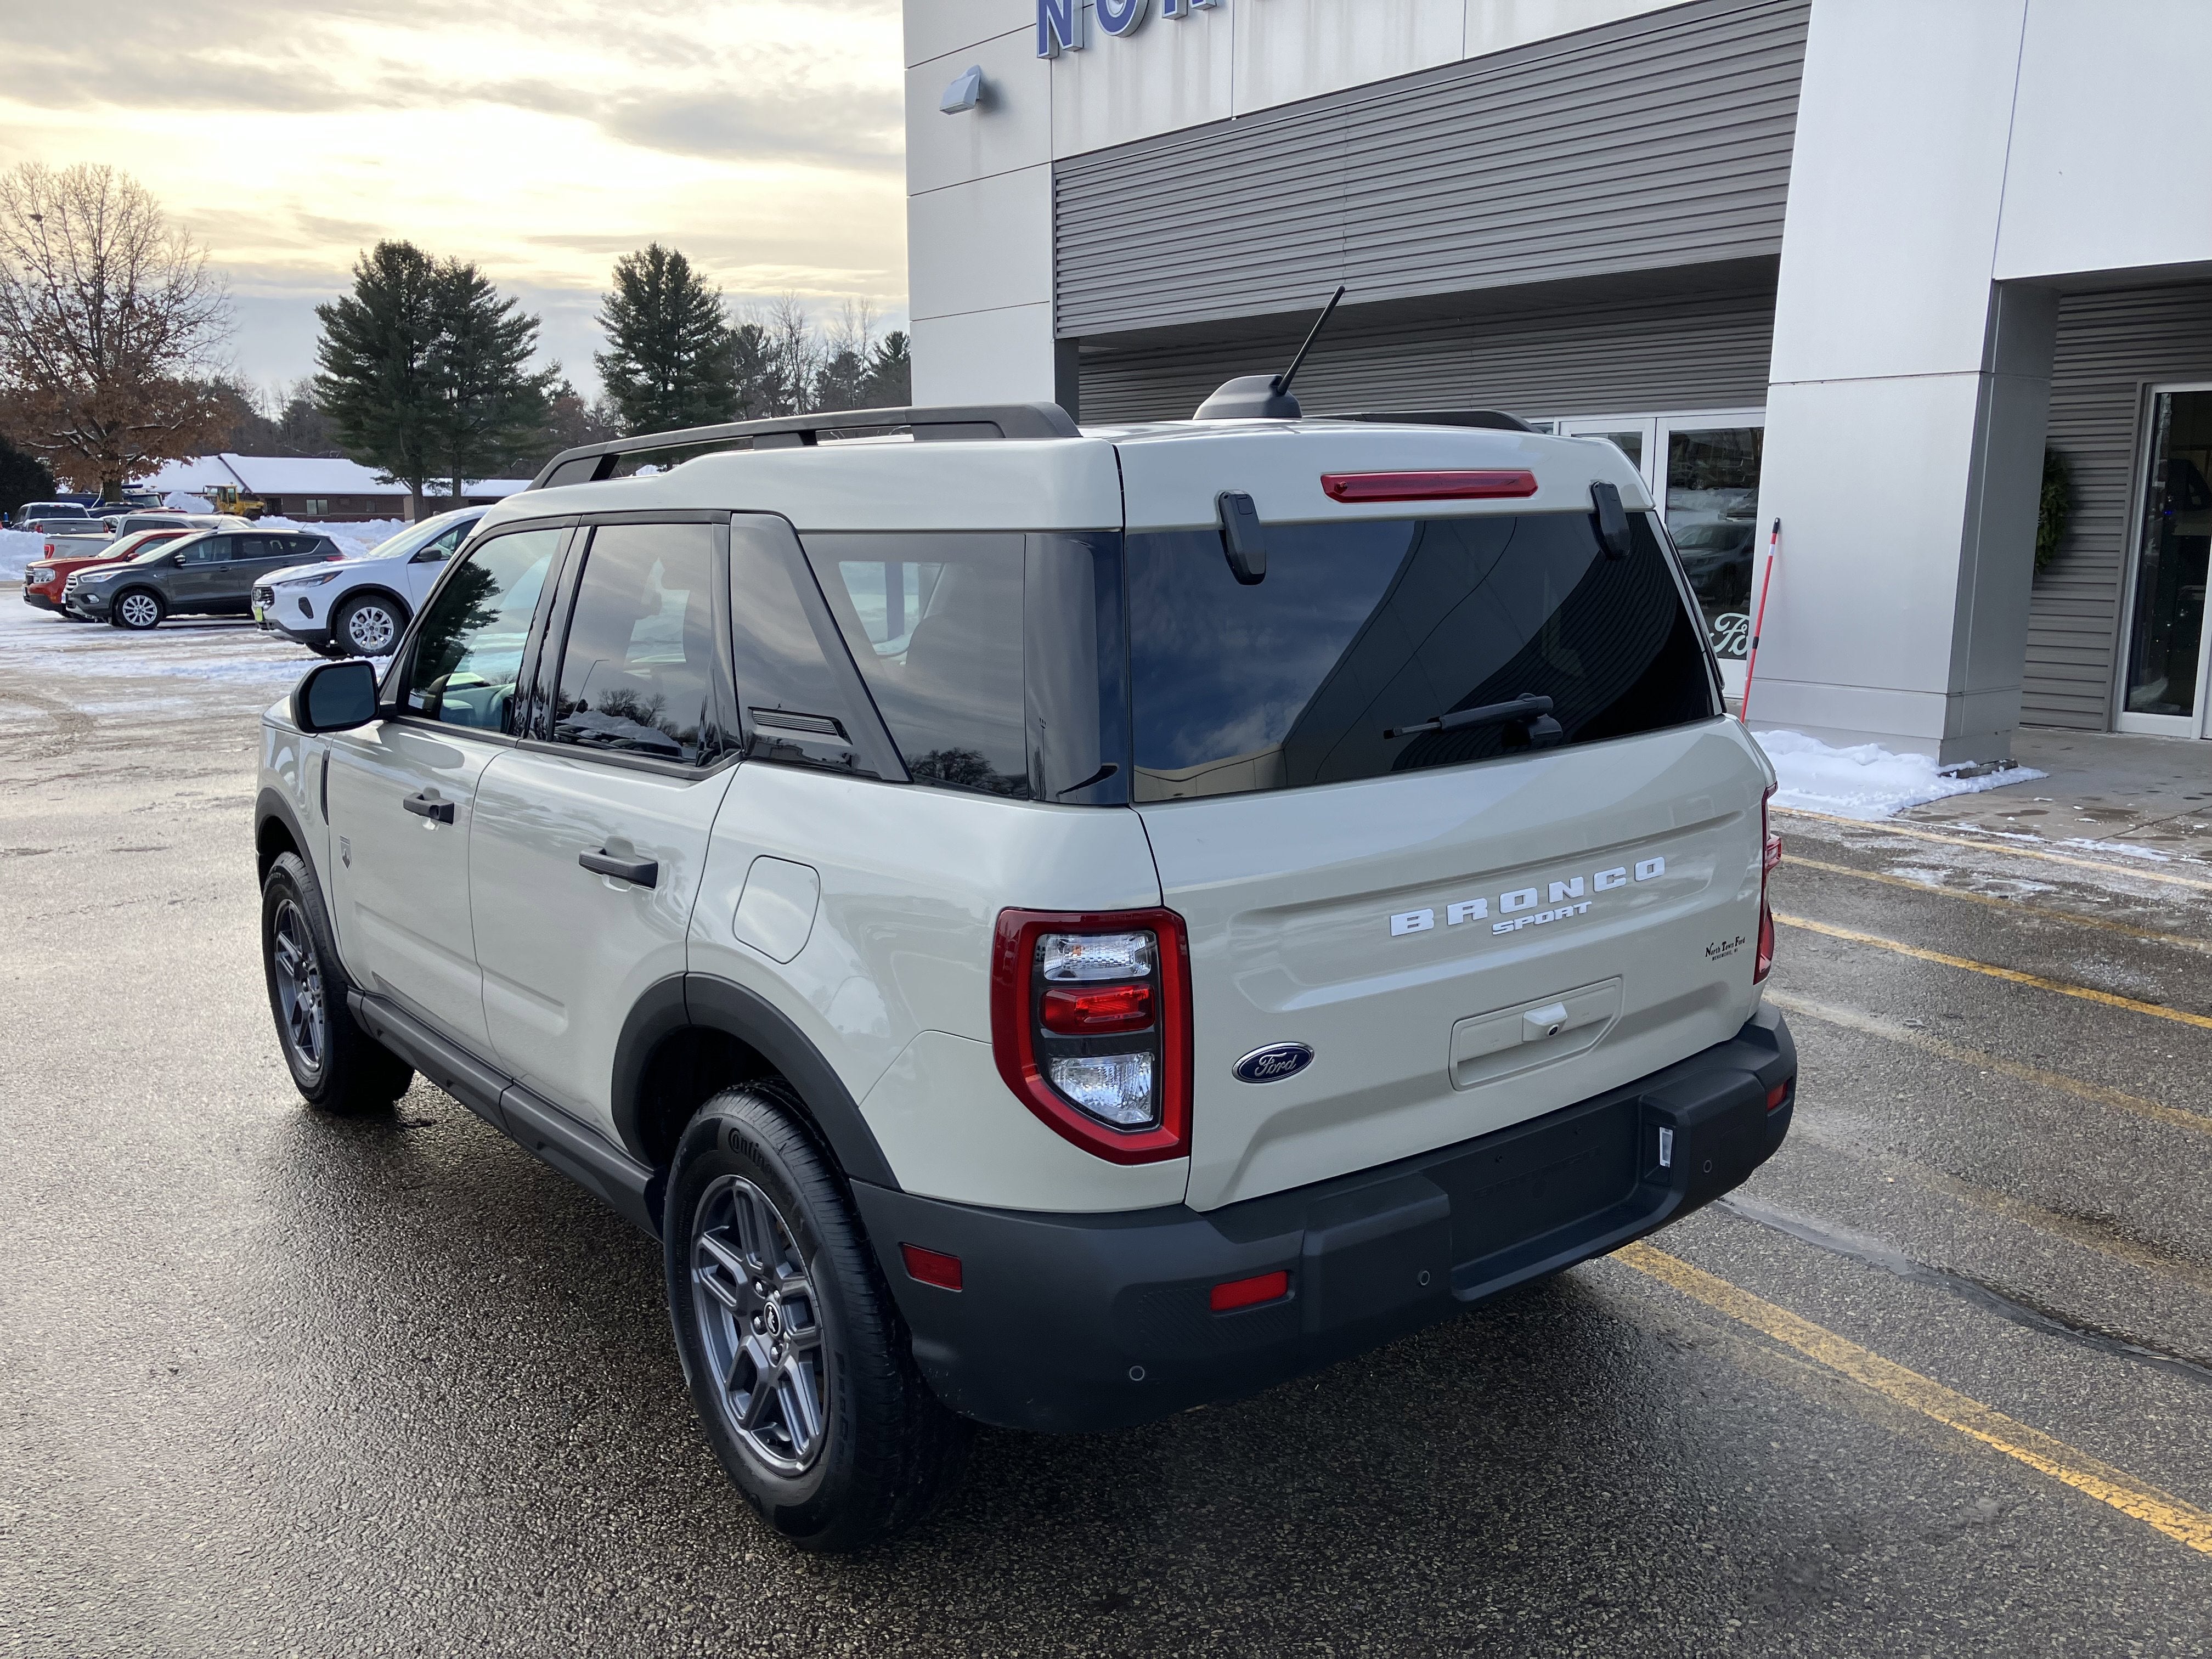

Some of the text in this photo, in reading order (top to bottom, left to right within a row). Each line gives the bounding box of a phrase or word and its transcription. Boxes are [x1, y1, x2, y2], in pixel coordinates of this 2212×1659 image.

[1709, 612, 1750, 656] Fo
[1390, 856, 1665, 936] BRONCO
[1492, 901, 1592, 935] SPORT
[1705, 936, 1746, 957] North Town Ford
[1254, 1052, 1298, 1077] Ford
